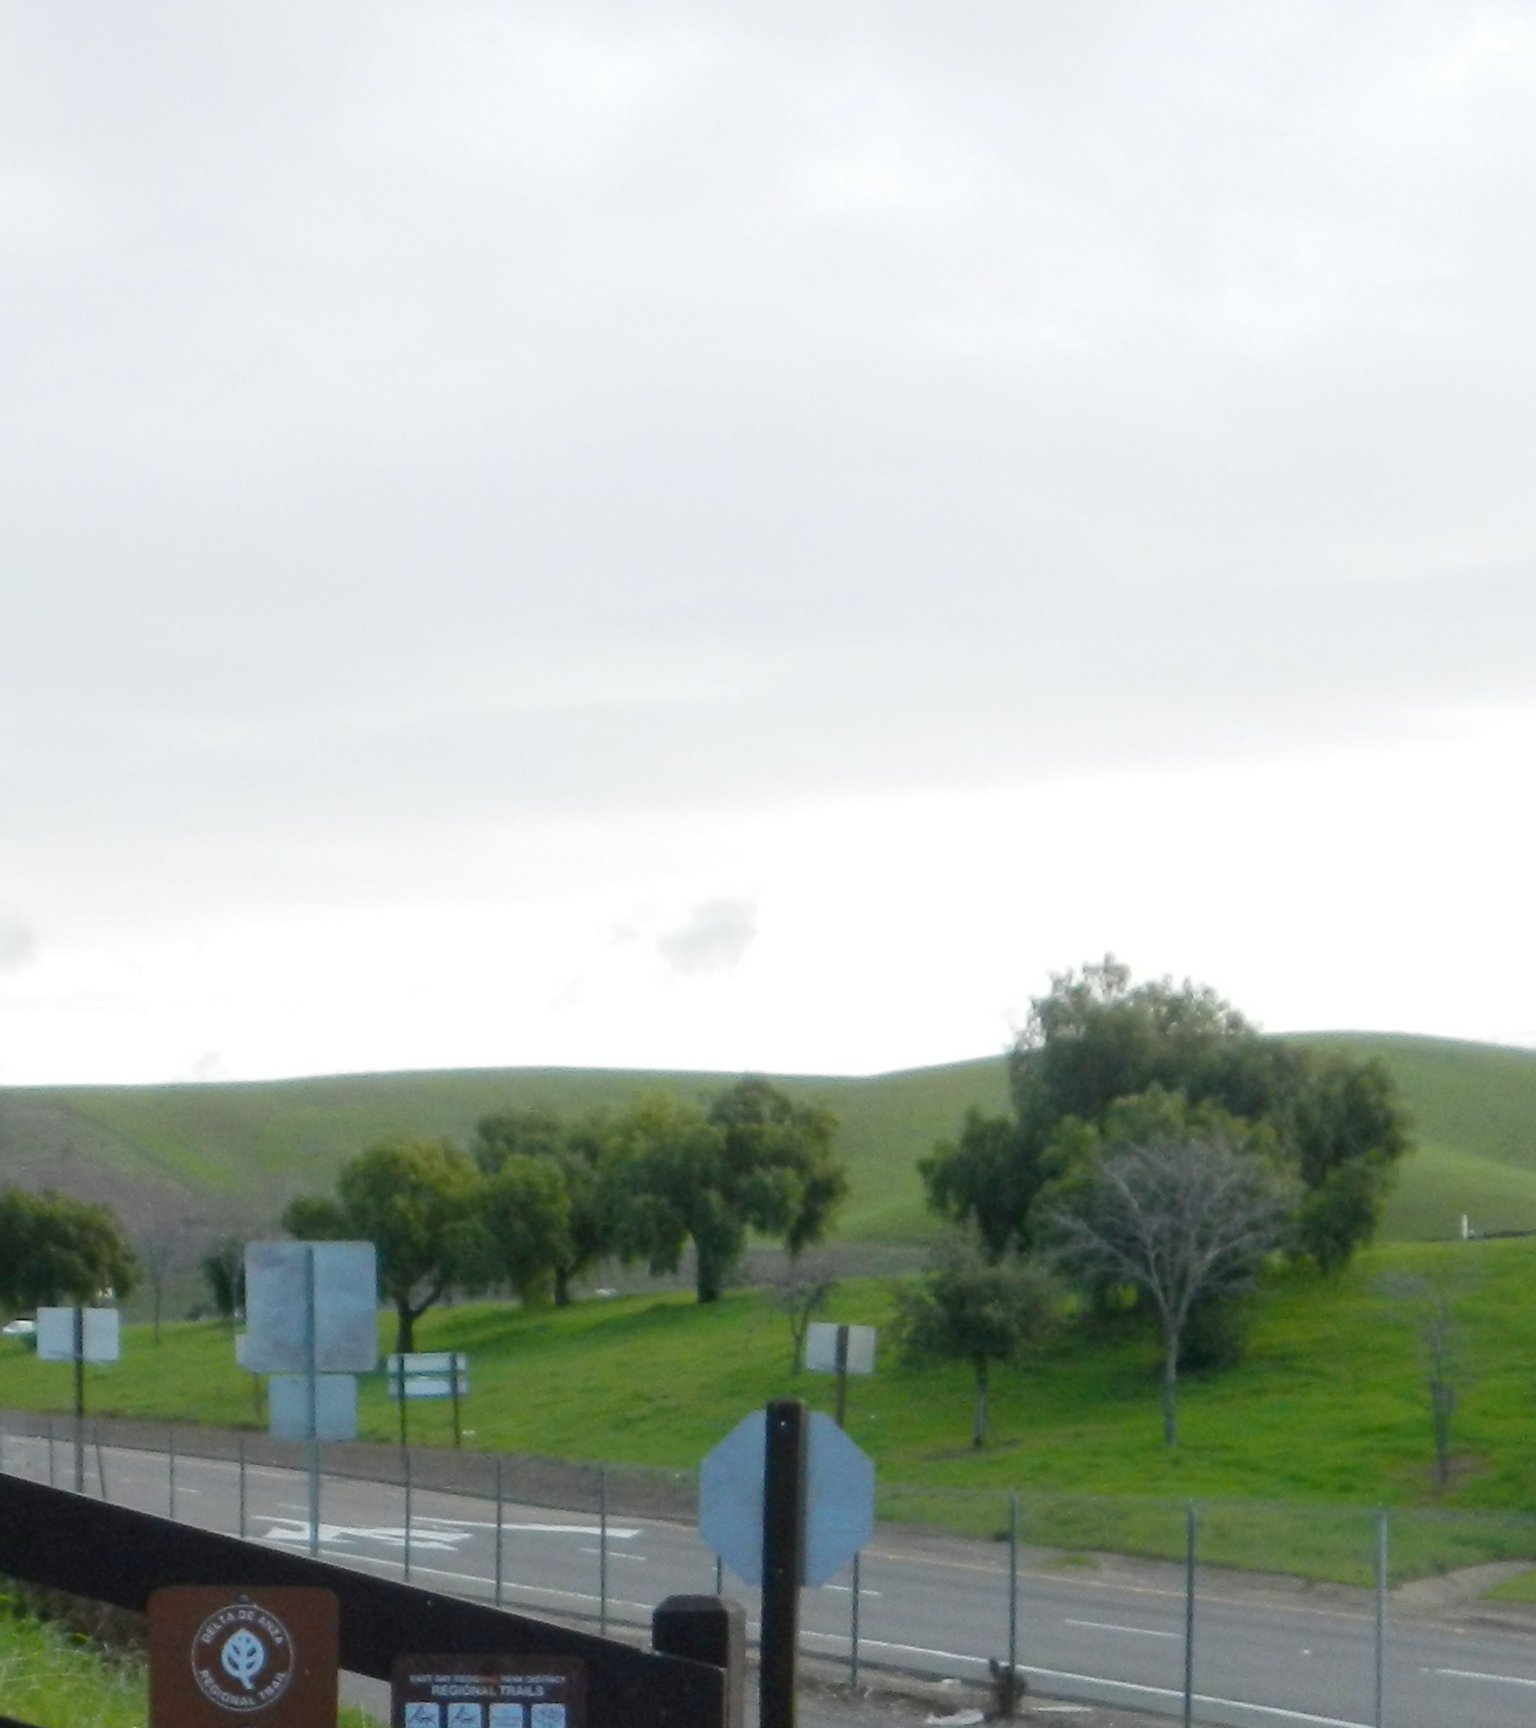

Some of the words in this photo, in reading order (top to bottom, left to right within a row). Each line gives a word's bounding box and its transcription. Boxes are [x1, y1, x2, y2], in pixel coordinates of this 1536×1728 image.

[201, 1613, 235, 1644] DELTA
[238, 1610, 255, 1621] DE
[258, 1616, 284, 1645] ANZA
[199, 1669, 255, 1706] REGIONAL
[257, 1672, 286, 1700] TRAIL
[431, 1684, 496, 1696] REGIONAL
[500, 1685, 544, 1697] TRAILS
